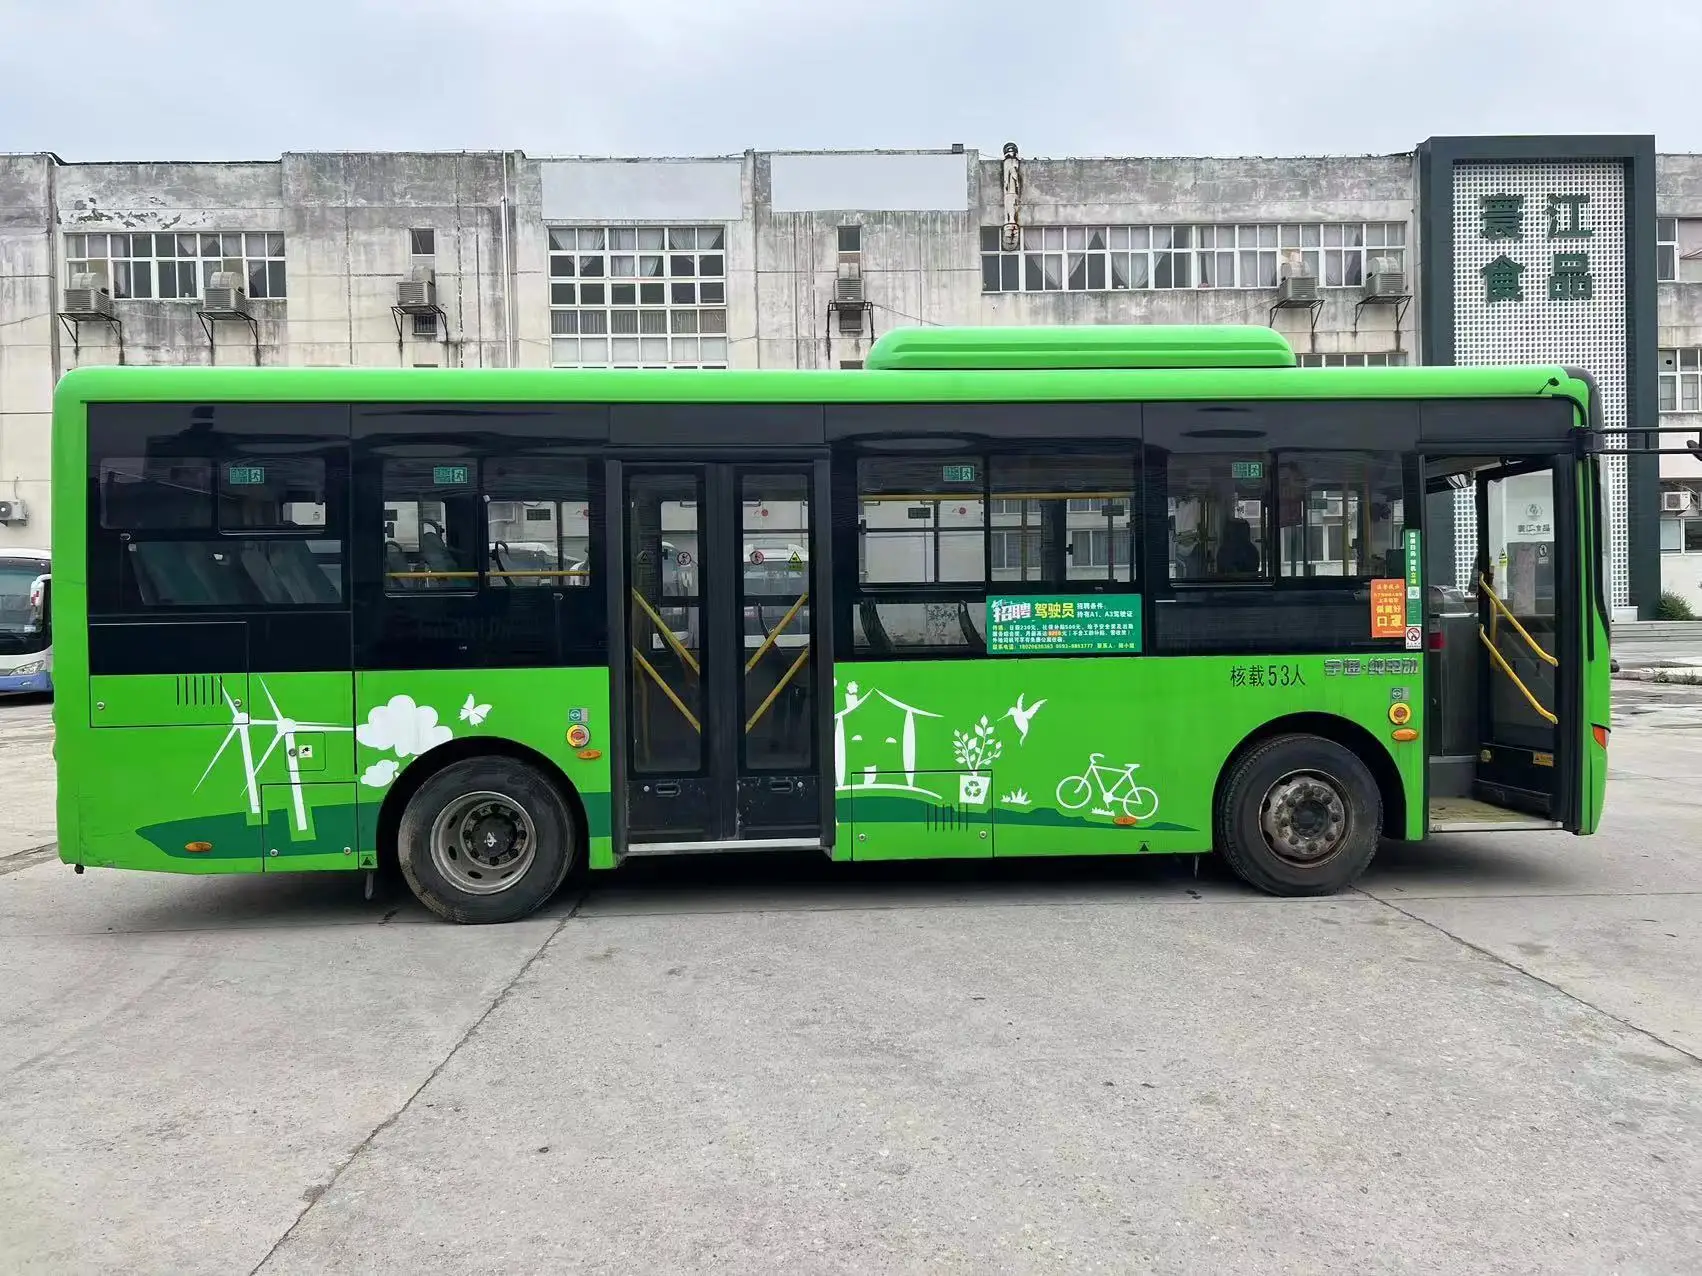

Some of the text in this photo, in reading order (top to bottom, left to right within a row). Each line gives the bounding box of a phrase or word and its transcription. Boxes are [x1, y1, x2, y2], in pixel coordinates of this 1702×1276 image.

[1480, 254, 1592, 303] 食品
[993, 602, 1075, 622] 招聘 驾驶员
[1376, 614, 1402, 628] 口罩
[1230, 664, 1306, 687] 核载53人
